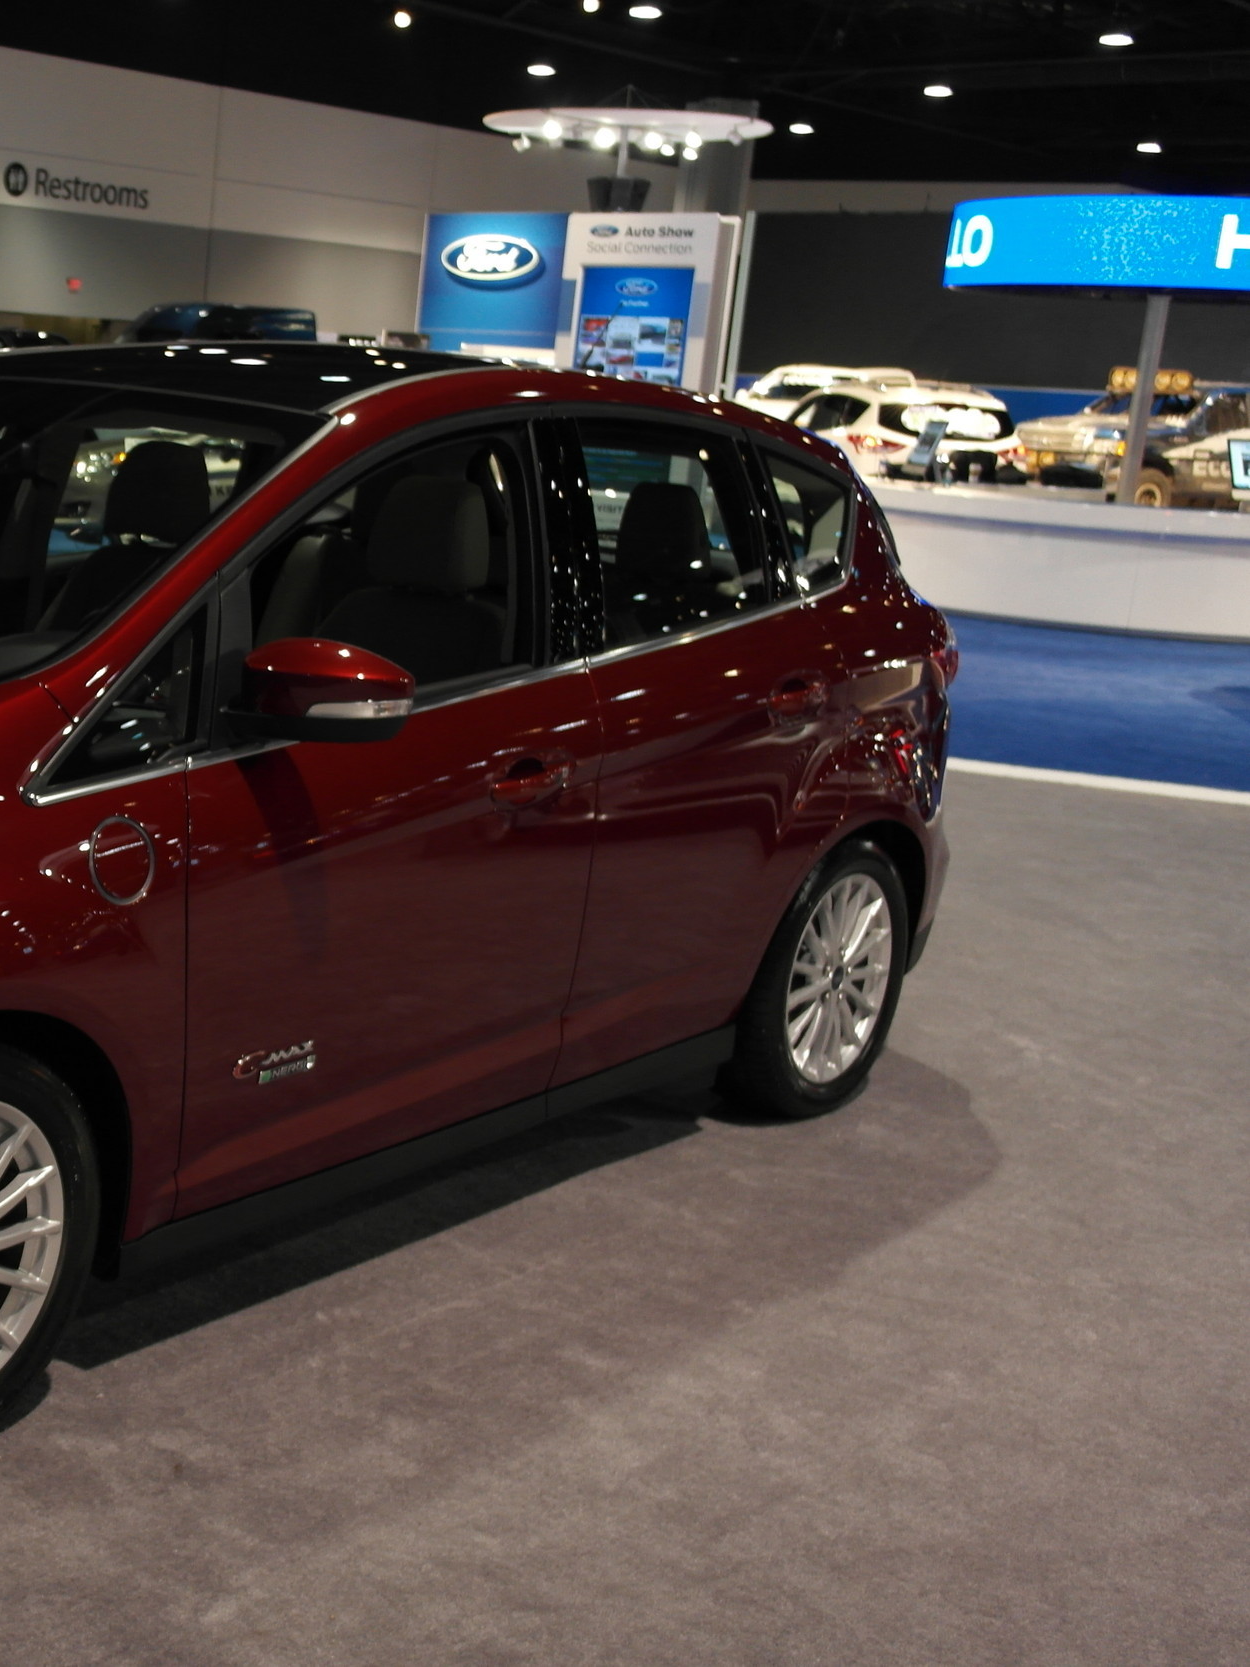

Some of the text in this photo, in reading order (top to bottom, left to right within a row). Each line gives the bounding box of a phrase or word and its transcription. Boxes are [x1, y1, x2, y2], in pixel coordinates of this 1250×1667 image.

[34, 168, 149, 210] Restrooms
[624, 226, 656, 237] Auto
[658, 226, 694, 238] Show
[456, 240, 519, 272] Ford
[587, 241, 692, 254] Social Connection
